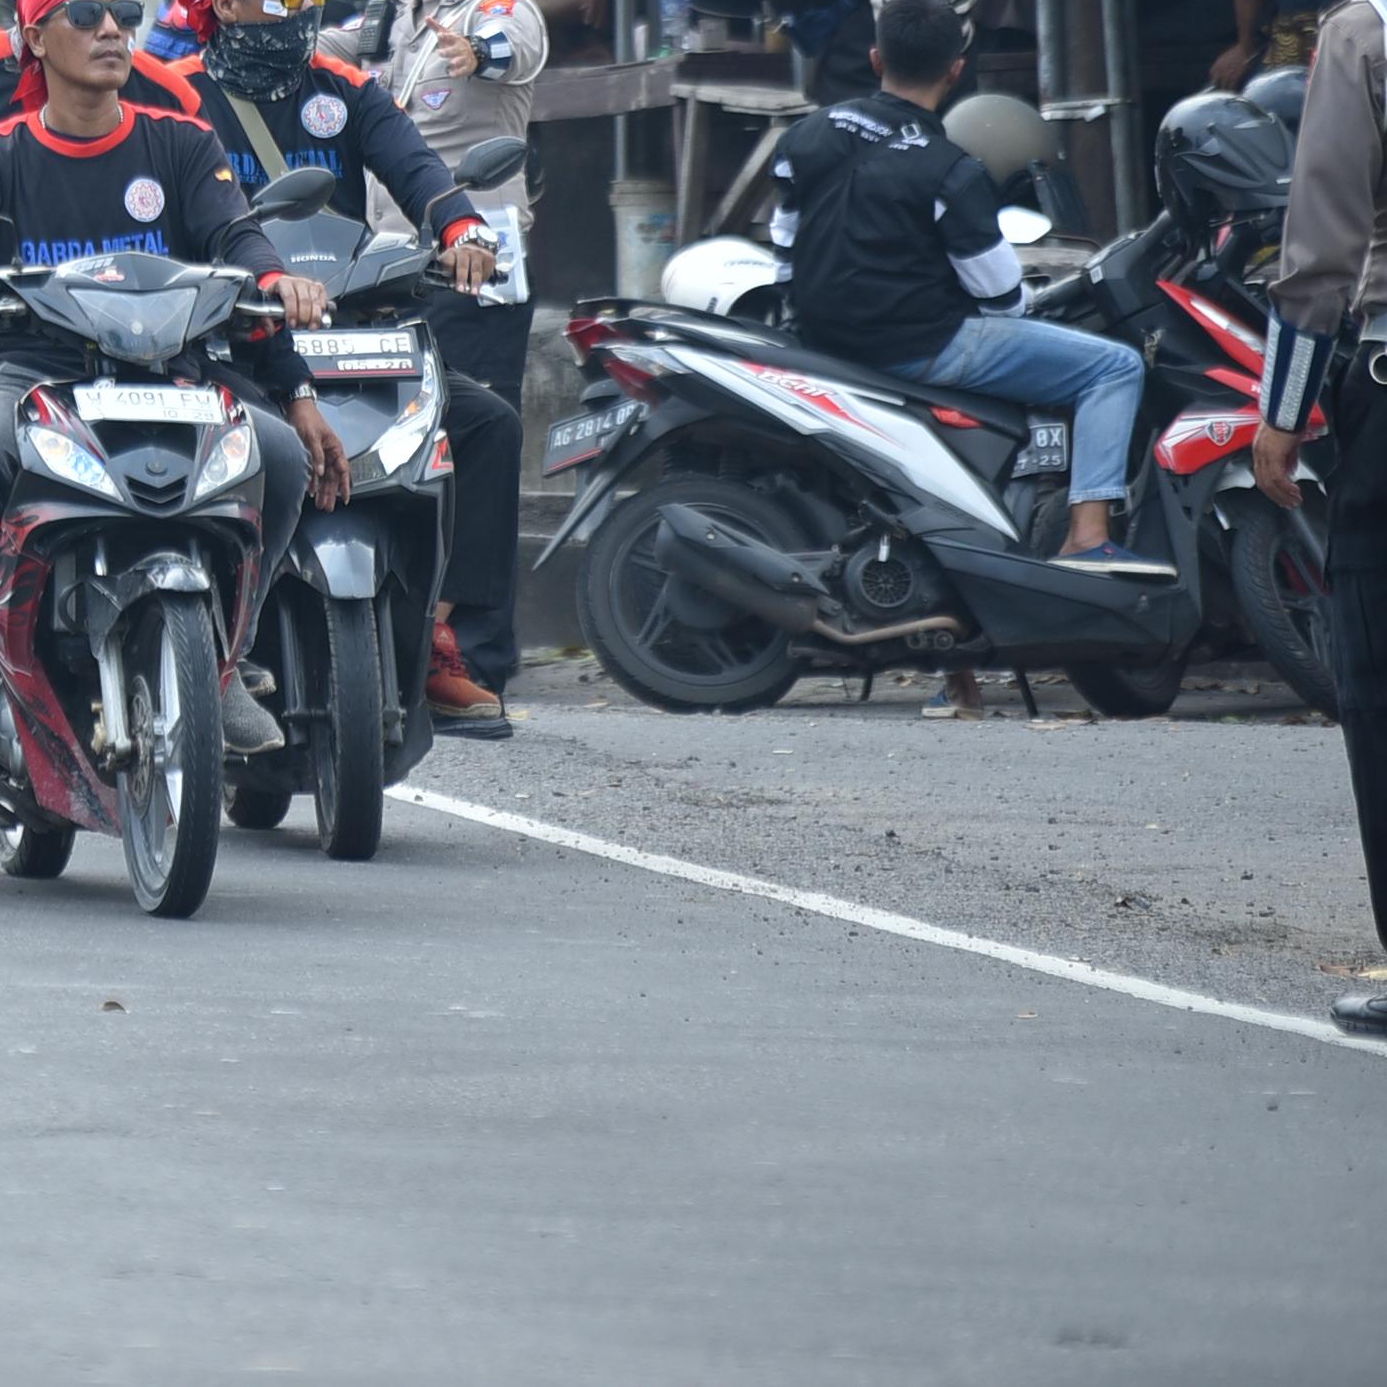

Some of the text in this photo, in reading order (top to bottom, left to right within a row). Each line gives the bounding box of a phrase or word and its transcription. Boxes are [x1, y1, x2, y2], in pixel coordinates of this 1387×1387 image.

[290, 253, 337, 263] HONDA
[296, 338, 355, 355] 6885
[116, 391, 164, 407] 4091
[574, 415, 614, 442] 2814
